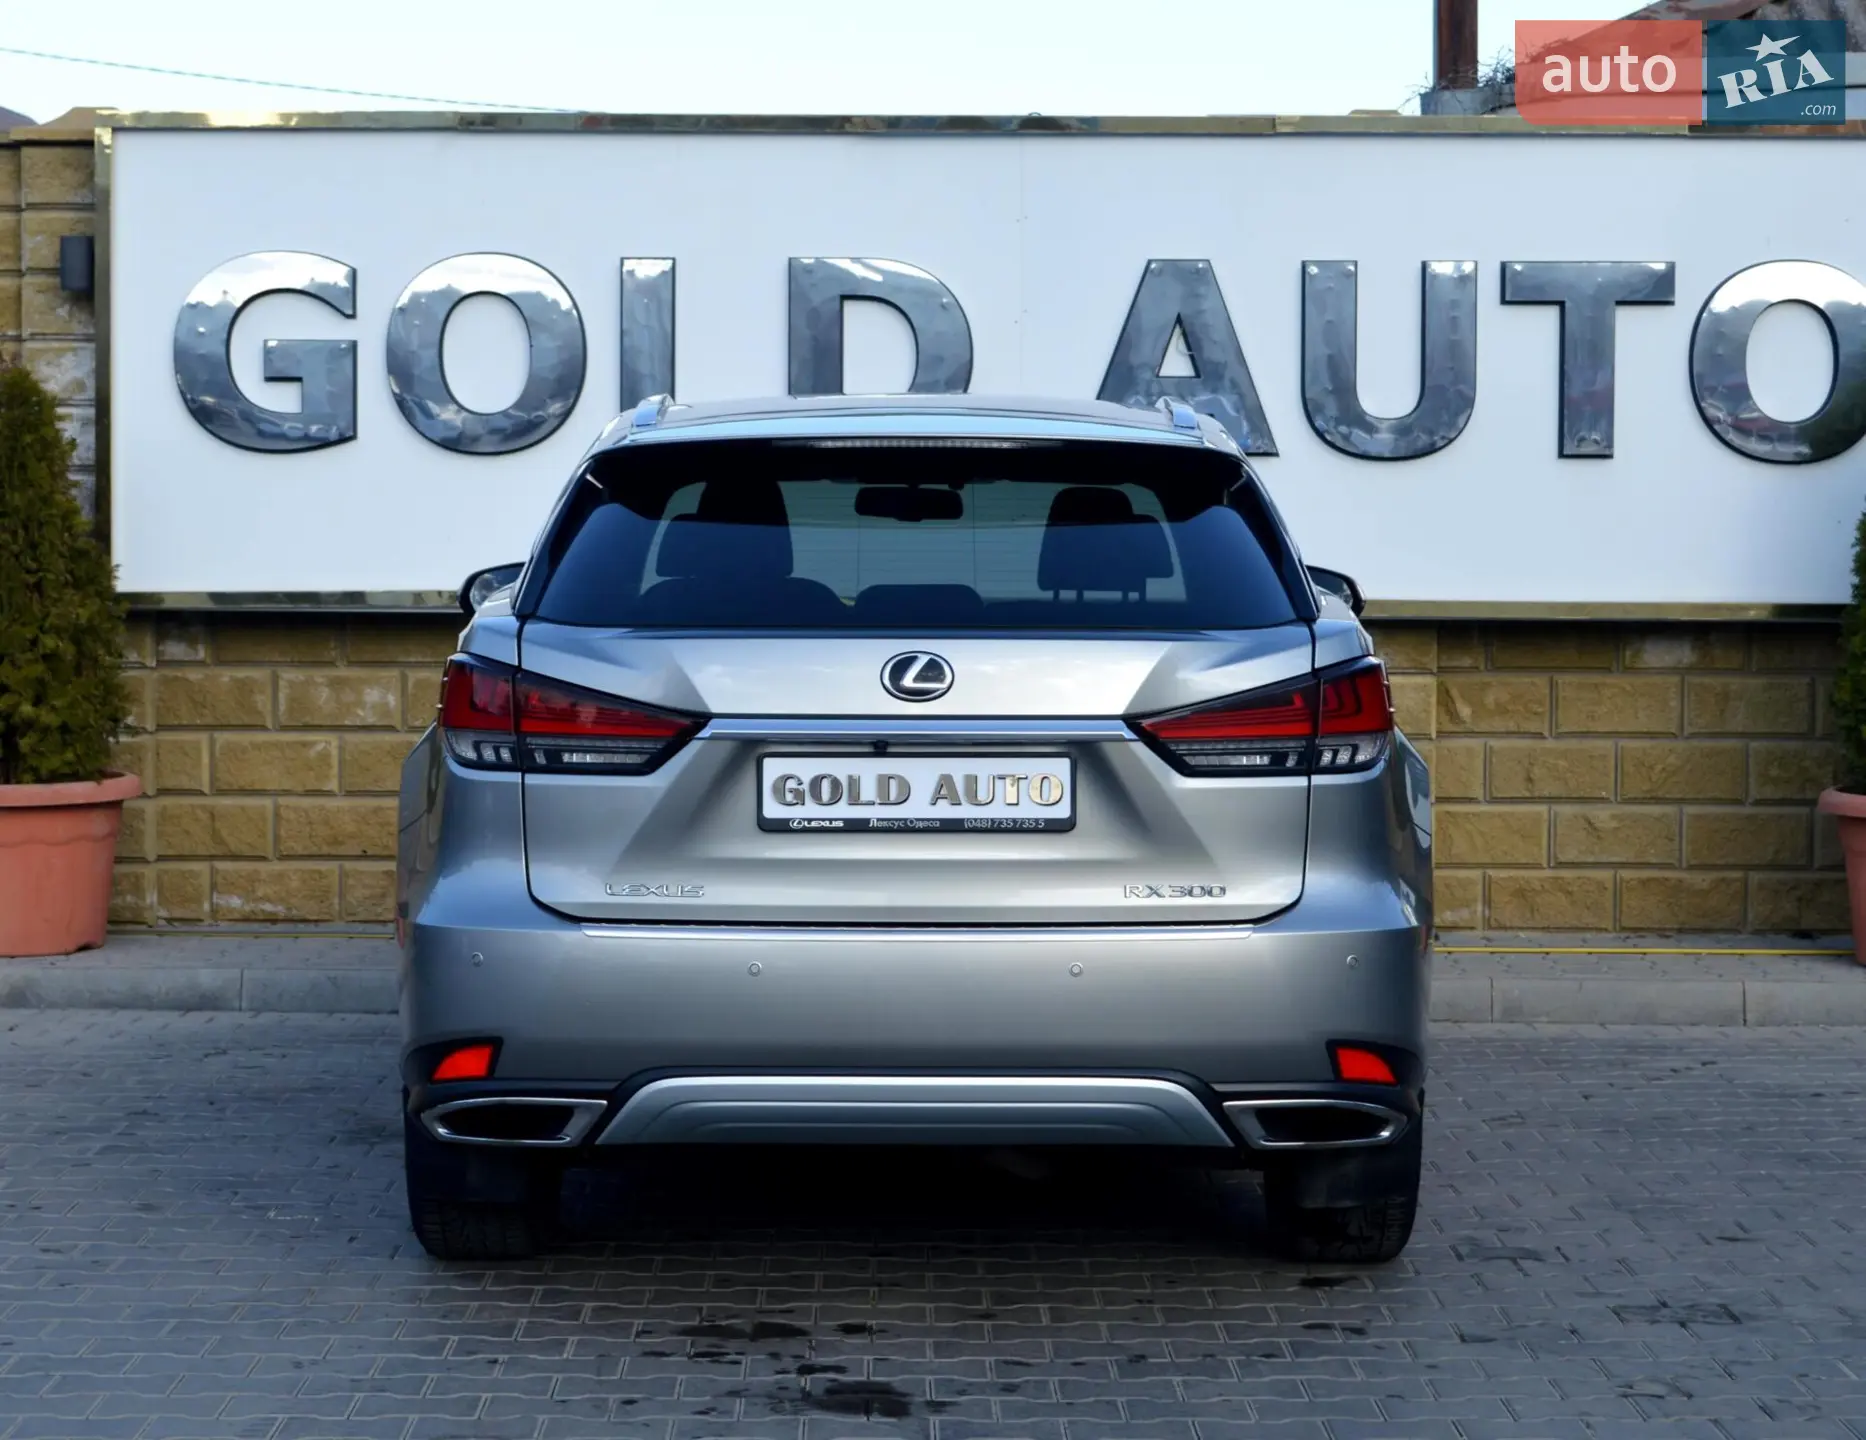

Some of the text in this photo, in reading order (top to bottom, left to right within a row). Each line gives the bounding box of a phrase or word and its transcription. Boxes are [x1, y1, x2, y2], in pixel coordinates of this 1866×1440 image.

[1097, 259, 1866, 465] AUTO
[771, 773, 1064, 806] GOLD AUTO
[868, 818, 904, 829] Лексус
[605, 882, 704, 898] LEXUS
